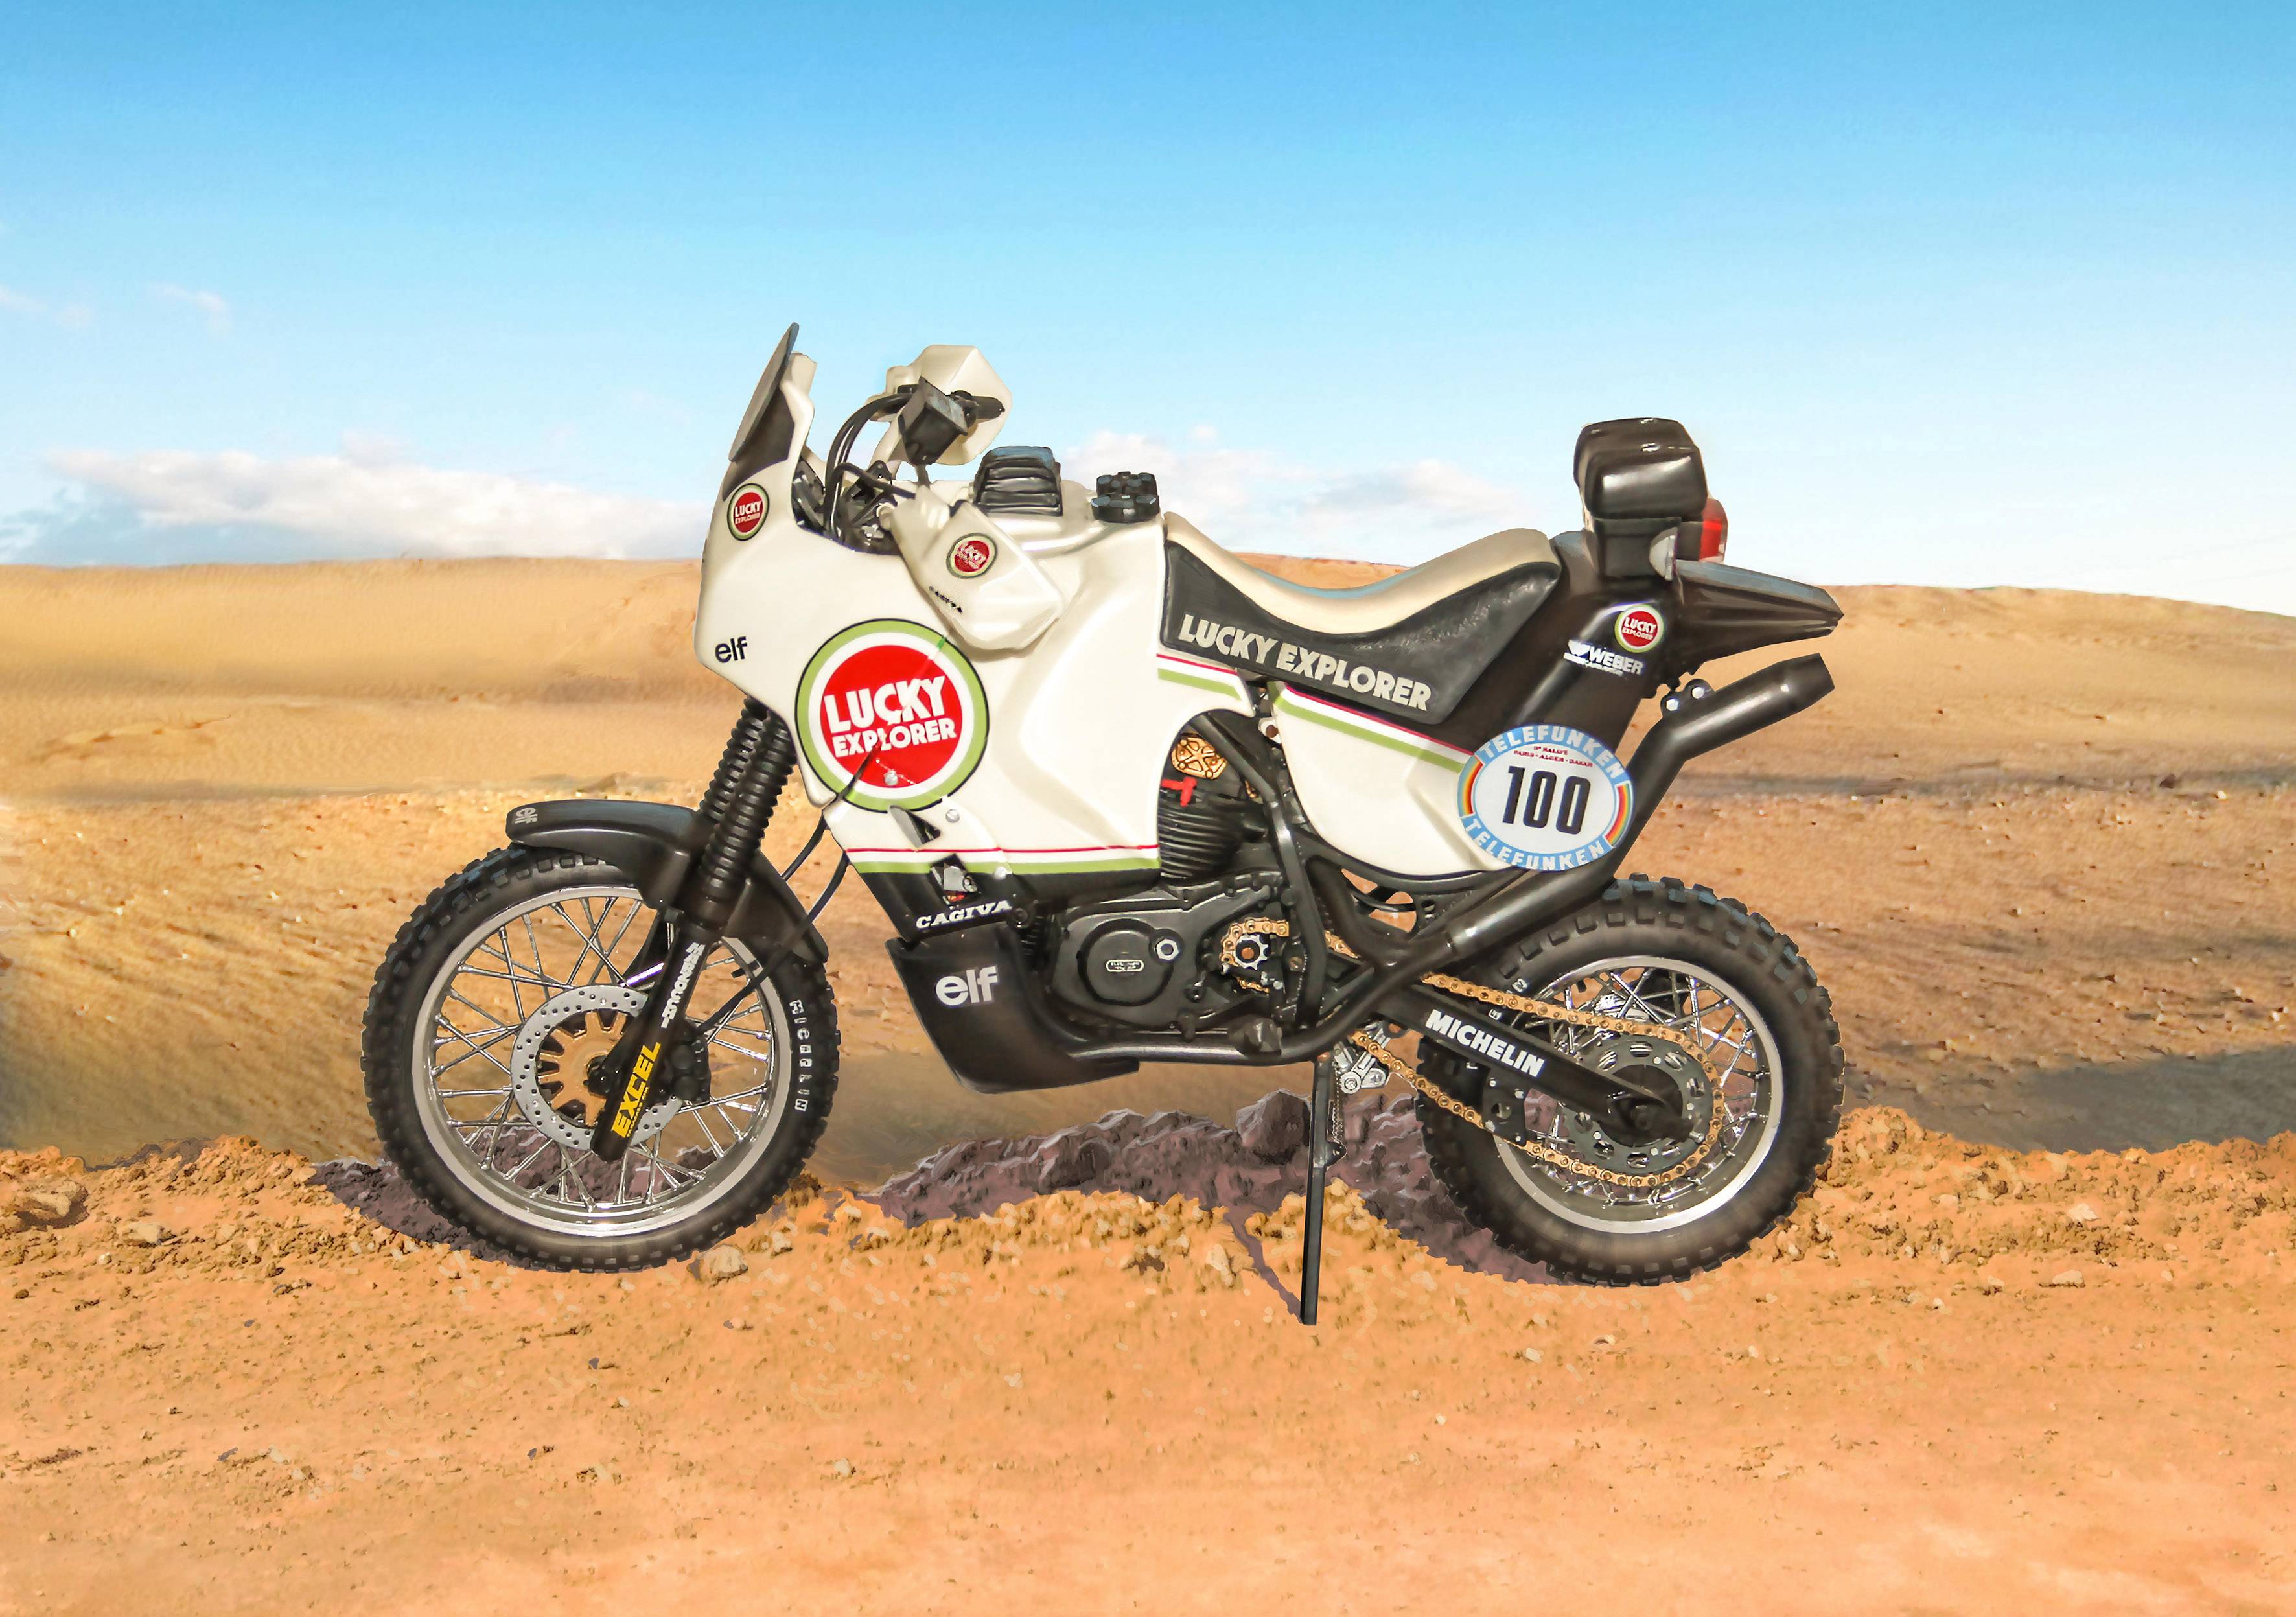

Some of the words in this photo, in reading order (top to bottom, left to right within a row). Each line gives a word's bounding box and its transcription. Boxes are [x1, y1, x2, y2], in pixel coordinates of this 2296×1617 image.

[735, 500, 761, 517] LUCKY
[715, 636, 747, 663] elf
[1624, 616, 1657, 634] LUCKY
[1179, 614, 1279, 664] LUCKY
[1275, 642, 1432, 712] EXPLORER
[1588, 646, 1644, 675] WEBER
[823, 675, 947, 734] LUCKY
[831, 717, 957, 758] EXPLORER
[1478, 725, 1626, 782] TELEFUNKEN
[1502, 765, 1592, 835] 100
[1462, 815, 1606, 871] TELEFUNKEN
[916, 900, 1013, 929] CAGIVA
[935, 965, 999, 1008] elf
[1426, 1008, 1546, 1078] MICHELIN
[610, 1041, 662, 1138] EXCEL
